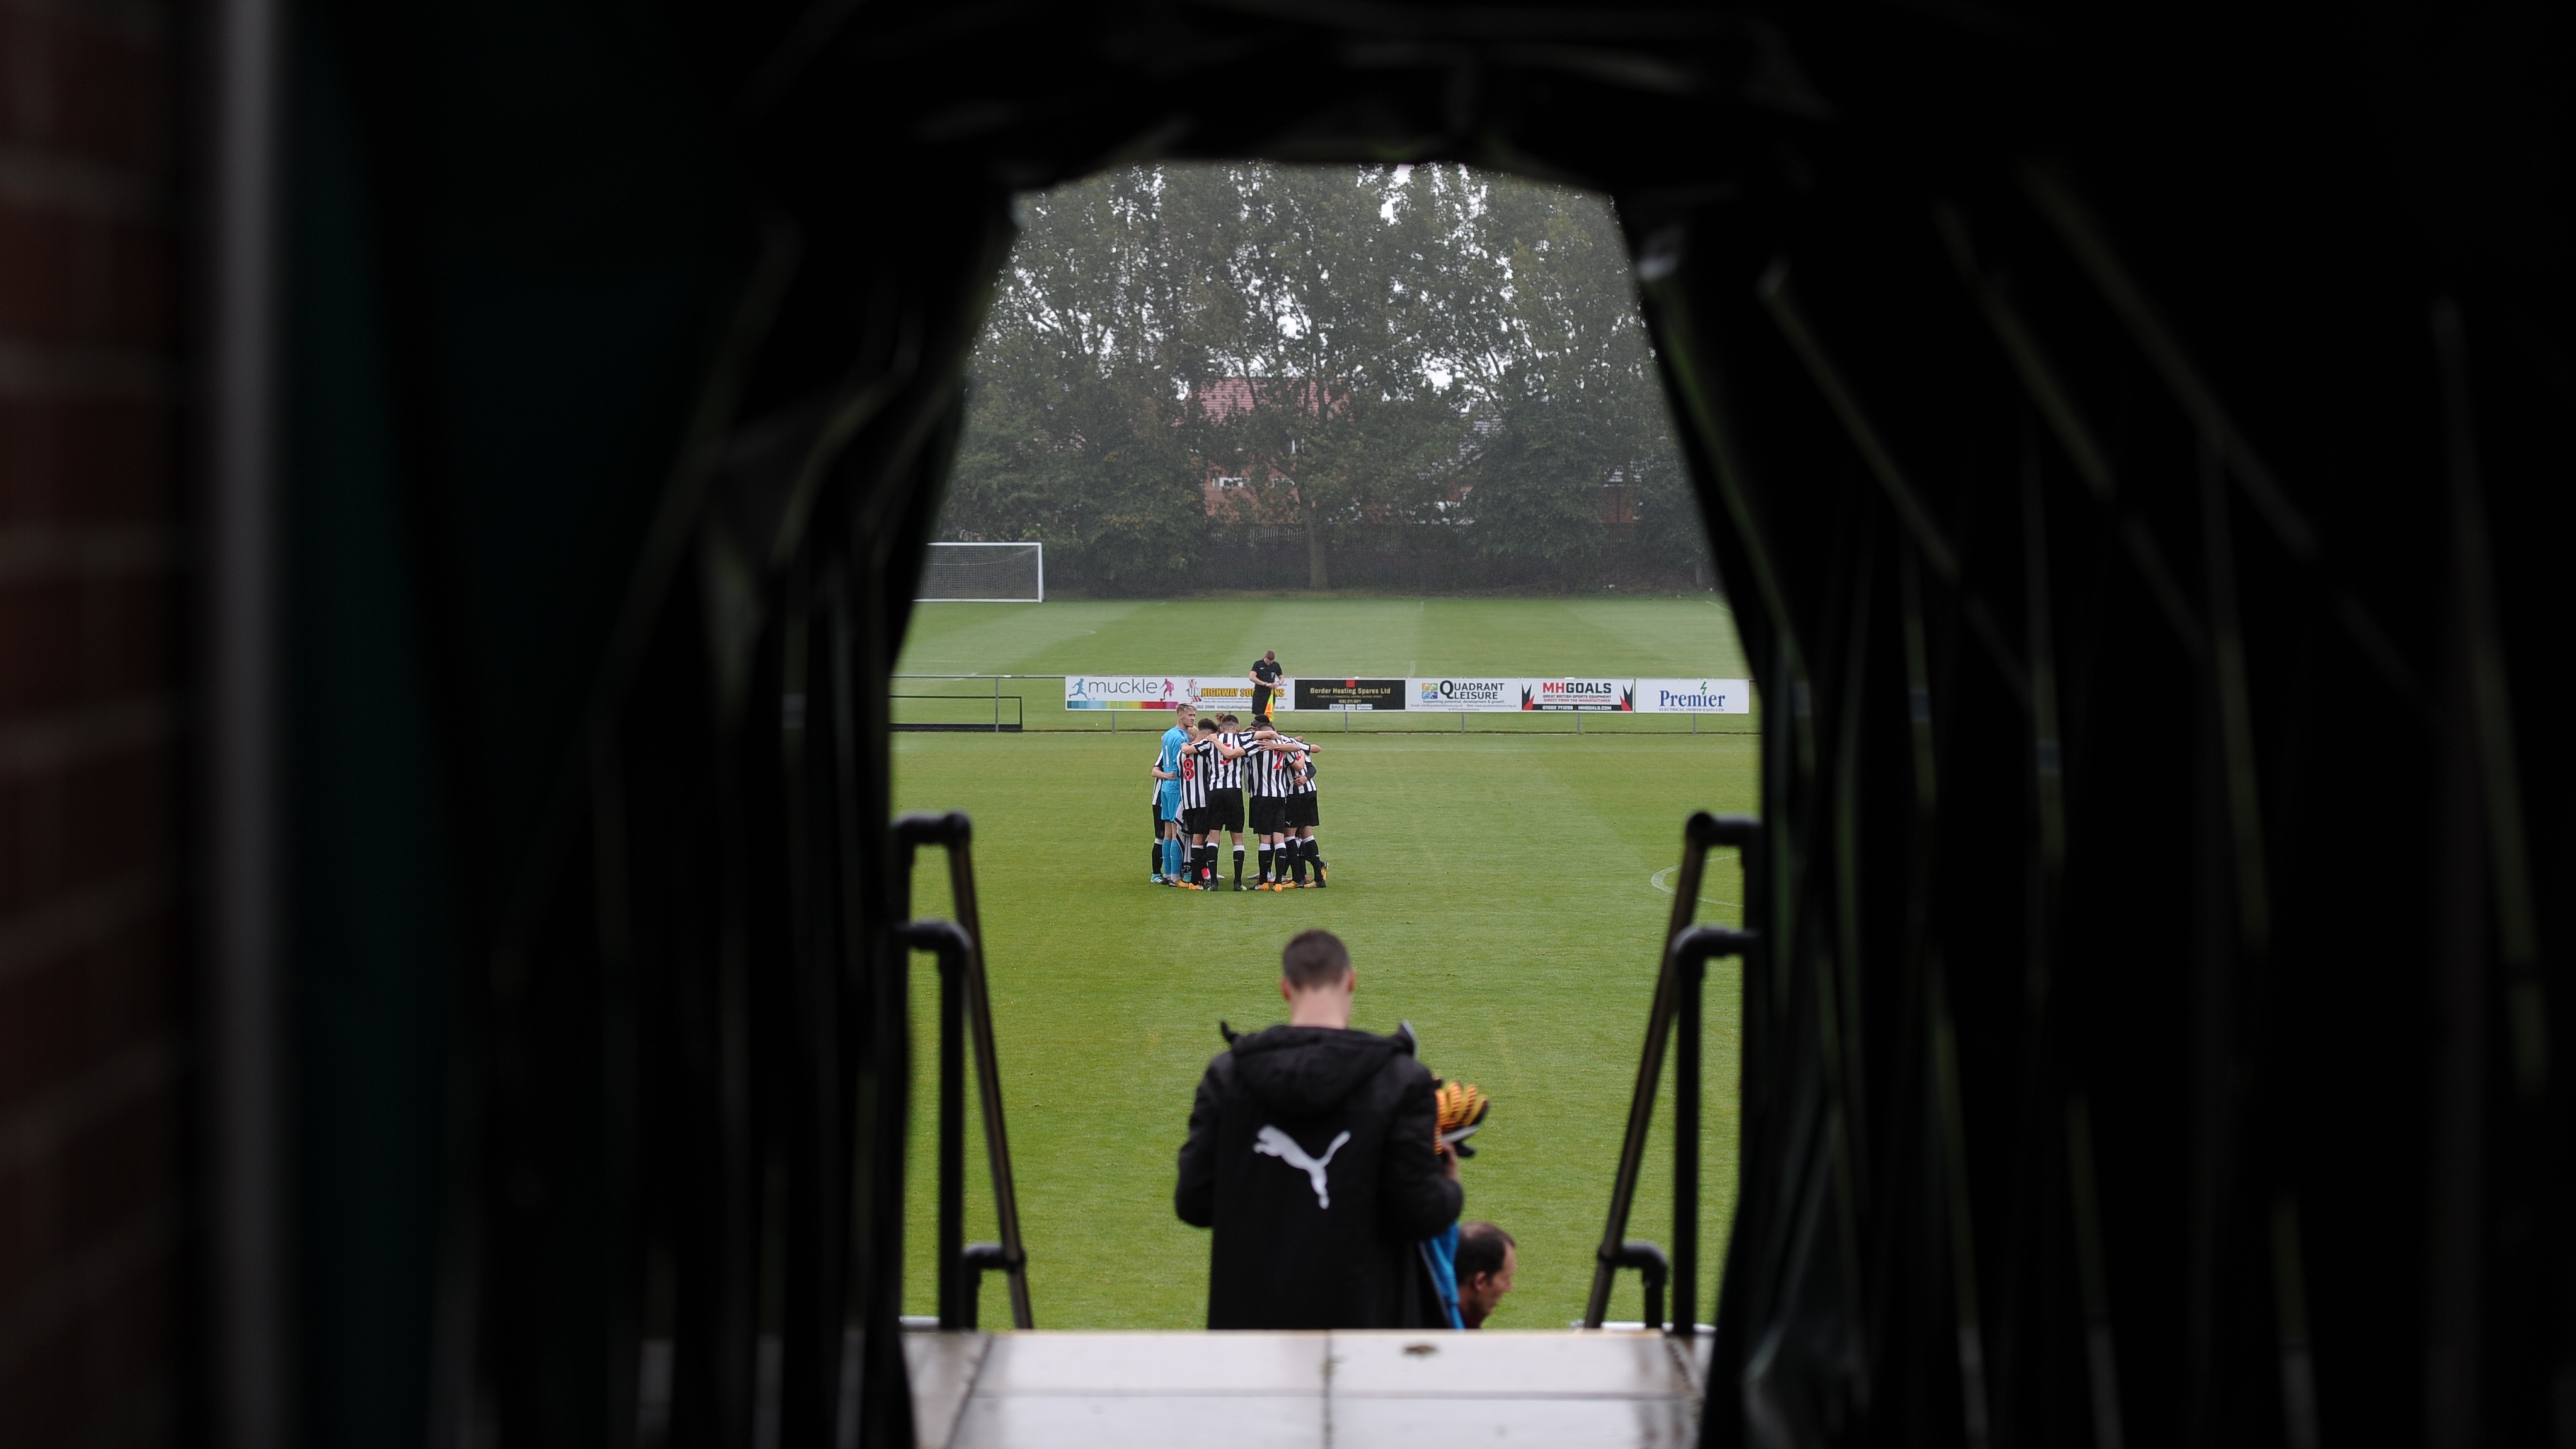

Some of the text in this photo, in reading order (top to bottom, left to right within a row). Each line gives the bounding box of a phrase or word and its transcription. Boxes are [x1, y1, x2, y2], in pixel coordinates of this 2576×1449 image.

[1089, 678, 1157, 694] muckle
[1201, 688, 1238, 697] HIGHWAY
[1440, 680, 1505, 699] QUADRANT
[1543, 683, 1611, 693] MHGOALS
[1660, 690, 1726, 706] Premier
[1183, 758, 1195, 781] 8
